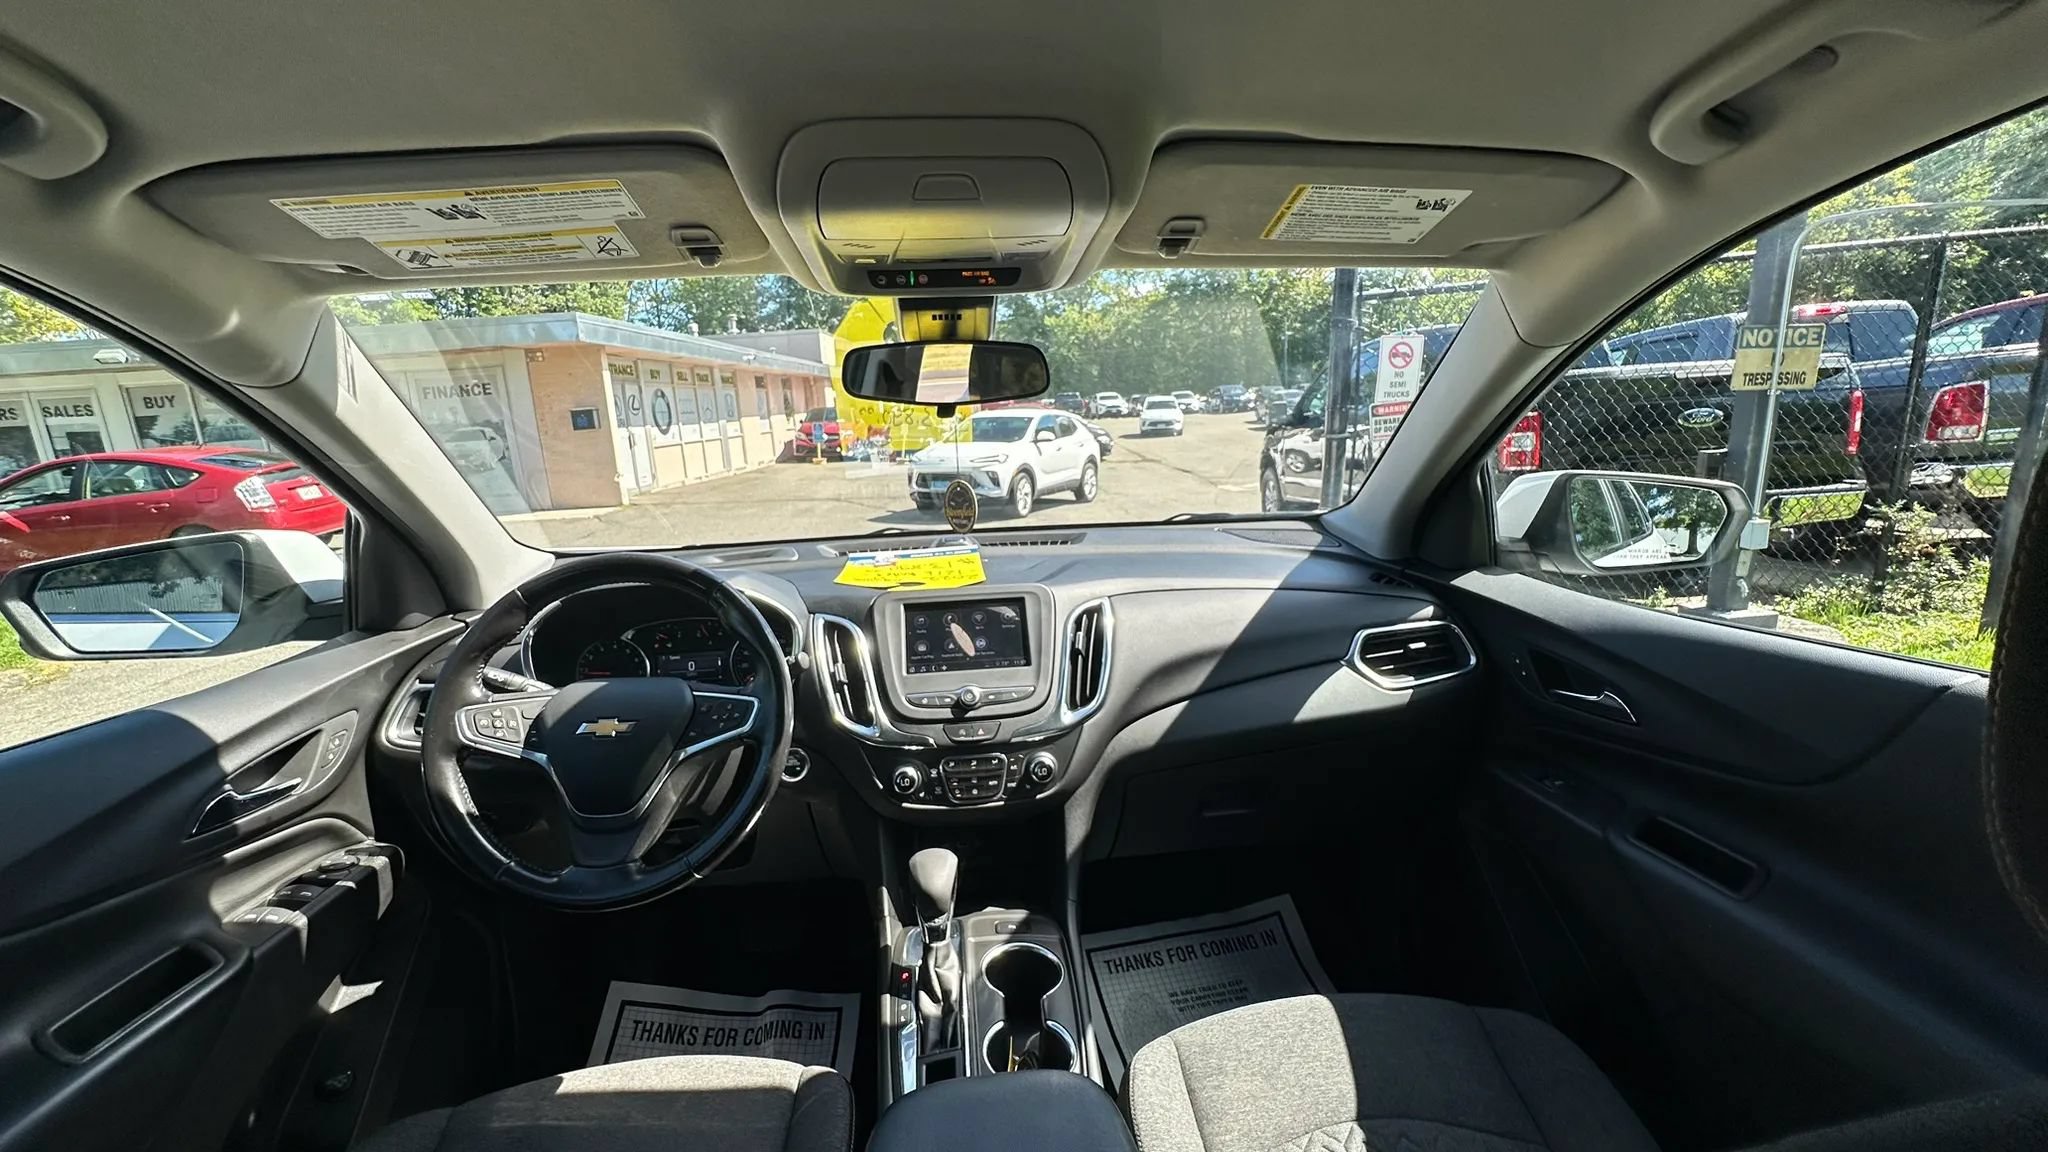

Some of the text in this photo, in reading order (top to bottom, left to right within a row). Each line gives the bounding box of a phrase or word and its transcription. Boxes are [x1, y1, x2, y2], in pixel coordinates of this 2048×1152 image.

[1742, 327, 1821, 347] NOICE
[1743, 370, 1807, 387] TRESPSSING
[422, 382, 493, 400] FINANCE
[1383, 390, 1411, 398] TRUCKS
[142, 395, 176, 409] BUY
[1378, 403, 1410, 415] WARNIN
[42, 404, 94, 418] SALES
[688, 661, 695, 671] 0
[1103, 929, 1278, 975] THANKS FOR COMING IN
[630, 1019, 826, 1047] THANKS FOR COMING IN
